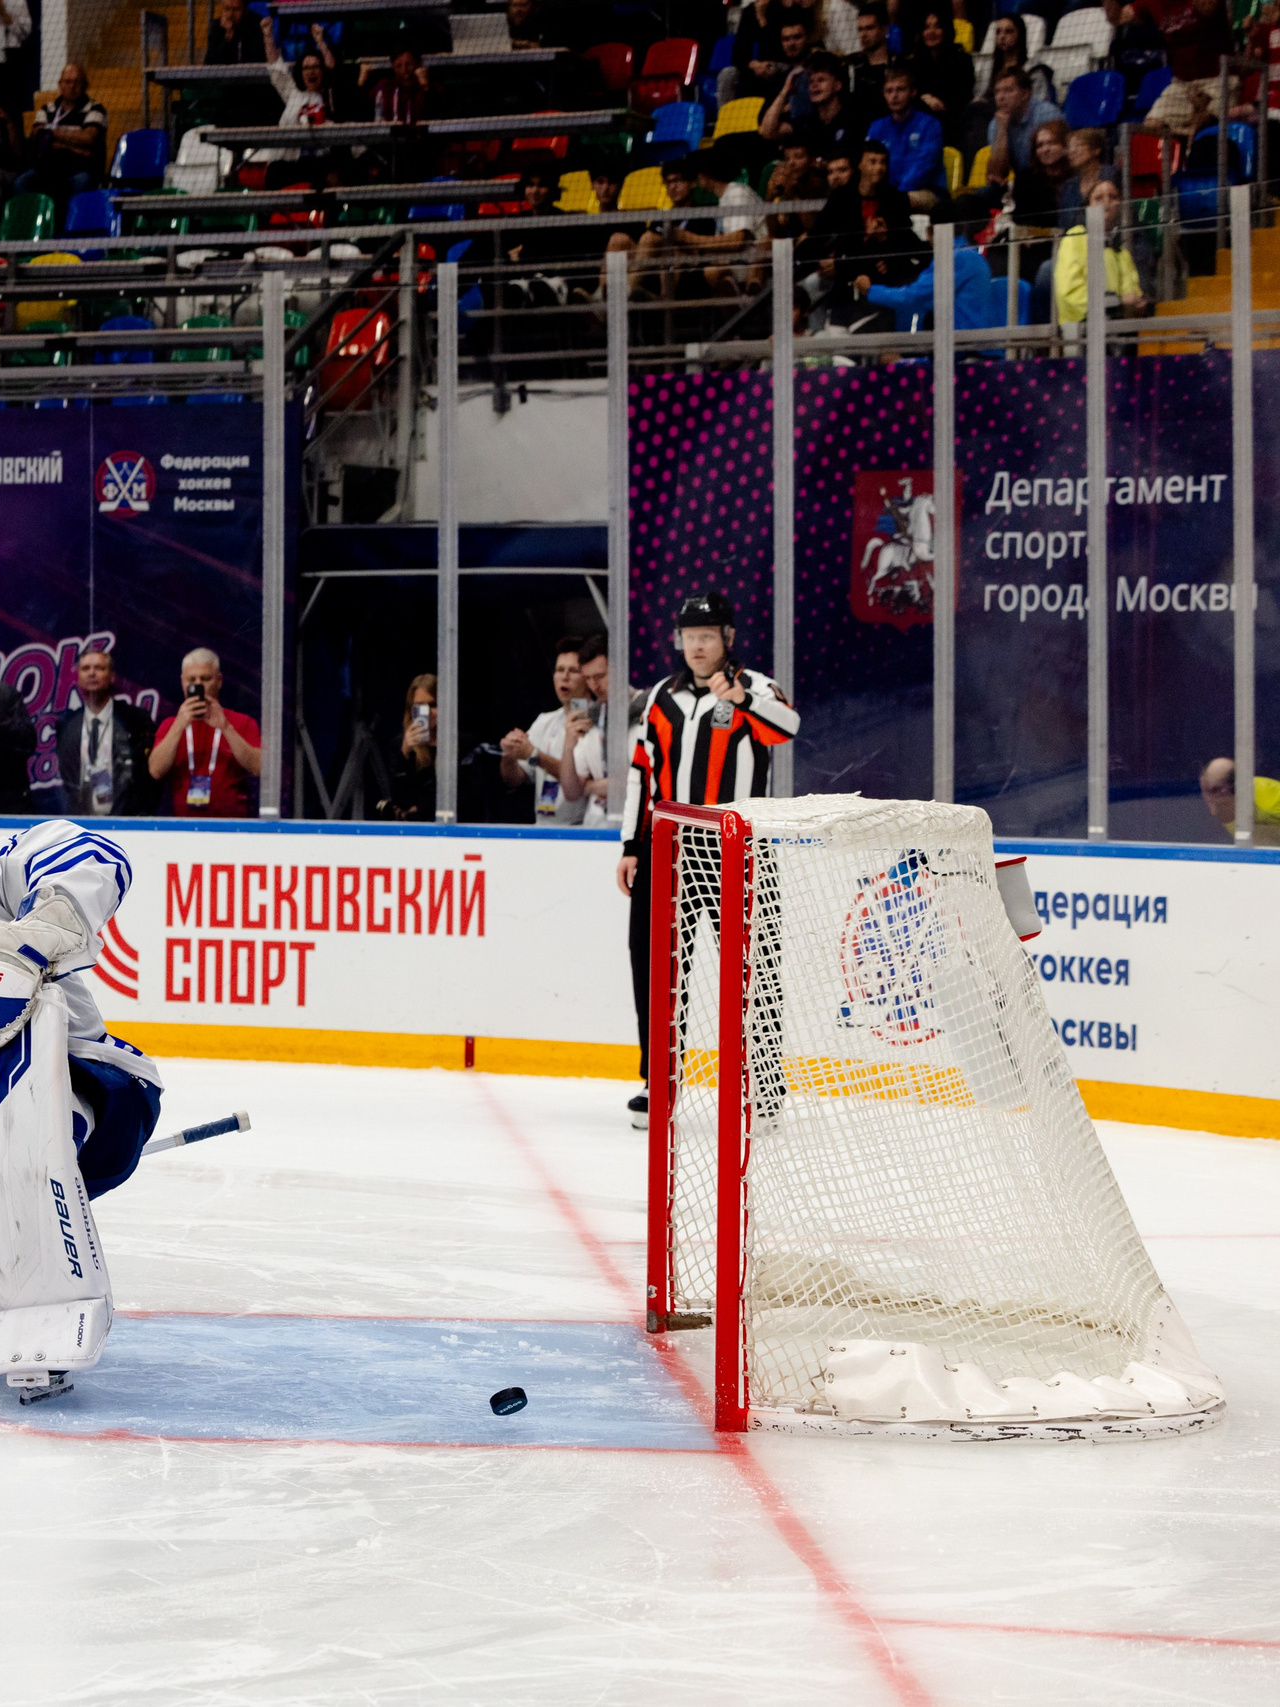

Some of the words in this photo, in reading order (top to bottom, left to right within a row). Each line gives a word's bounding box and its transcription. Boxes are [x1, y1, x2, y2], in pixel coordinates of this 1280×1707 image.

[160, 453, 250, 472] Федерация
[178, 477, 232, 491] хоккея
[173, 496, 235, 512] Москвы
[985, 531, 1090, 571] спорт
[984, 584, 1090, 623] город
[165, 853, 486, 938] МОСКОВСКИЙ
[1033, 890, 1168, 930] дерация
[165, 937, 316, 1008] СПОРТ
[1051, 1018, 1138, 1052] сквы
[76, 1312, 86, 1348] SHADOW
